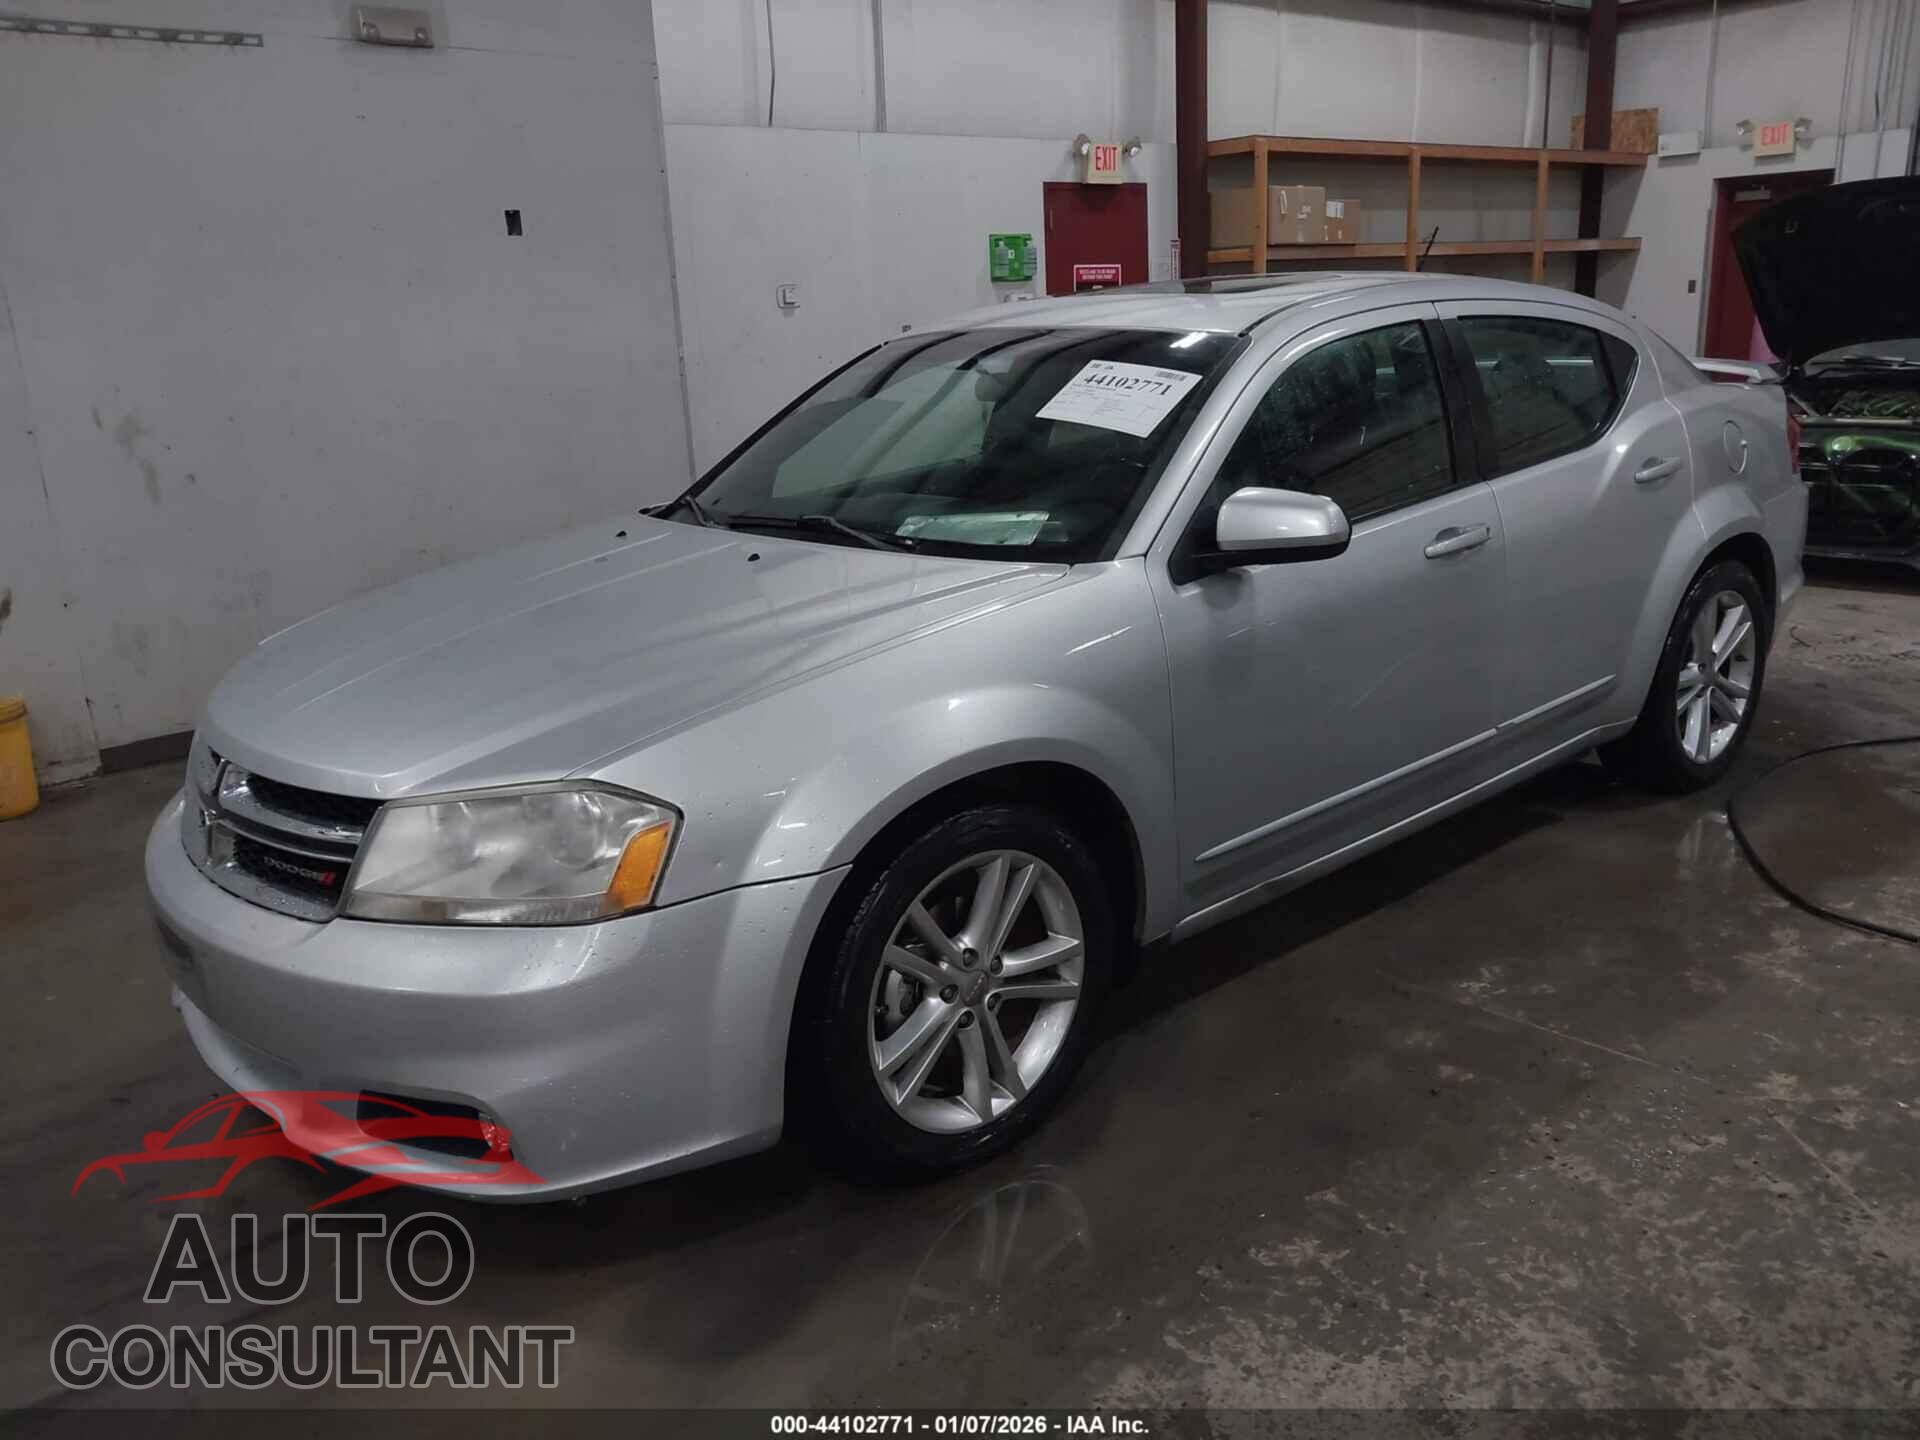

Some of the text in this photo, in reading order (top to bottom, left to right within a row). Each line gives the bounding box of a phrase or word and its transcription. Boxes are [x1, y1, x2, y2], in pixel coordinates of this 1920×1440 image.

[1762, 123, 1788, 145] EXIT
[1095, 146, 1117, 171] EXIT
[1084, 373, 1172, 396] 44102771
